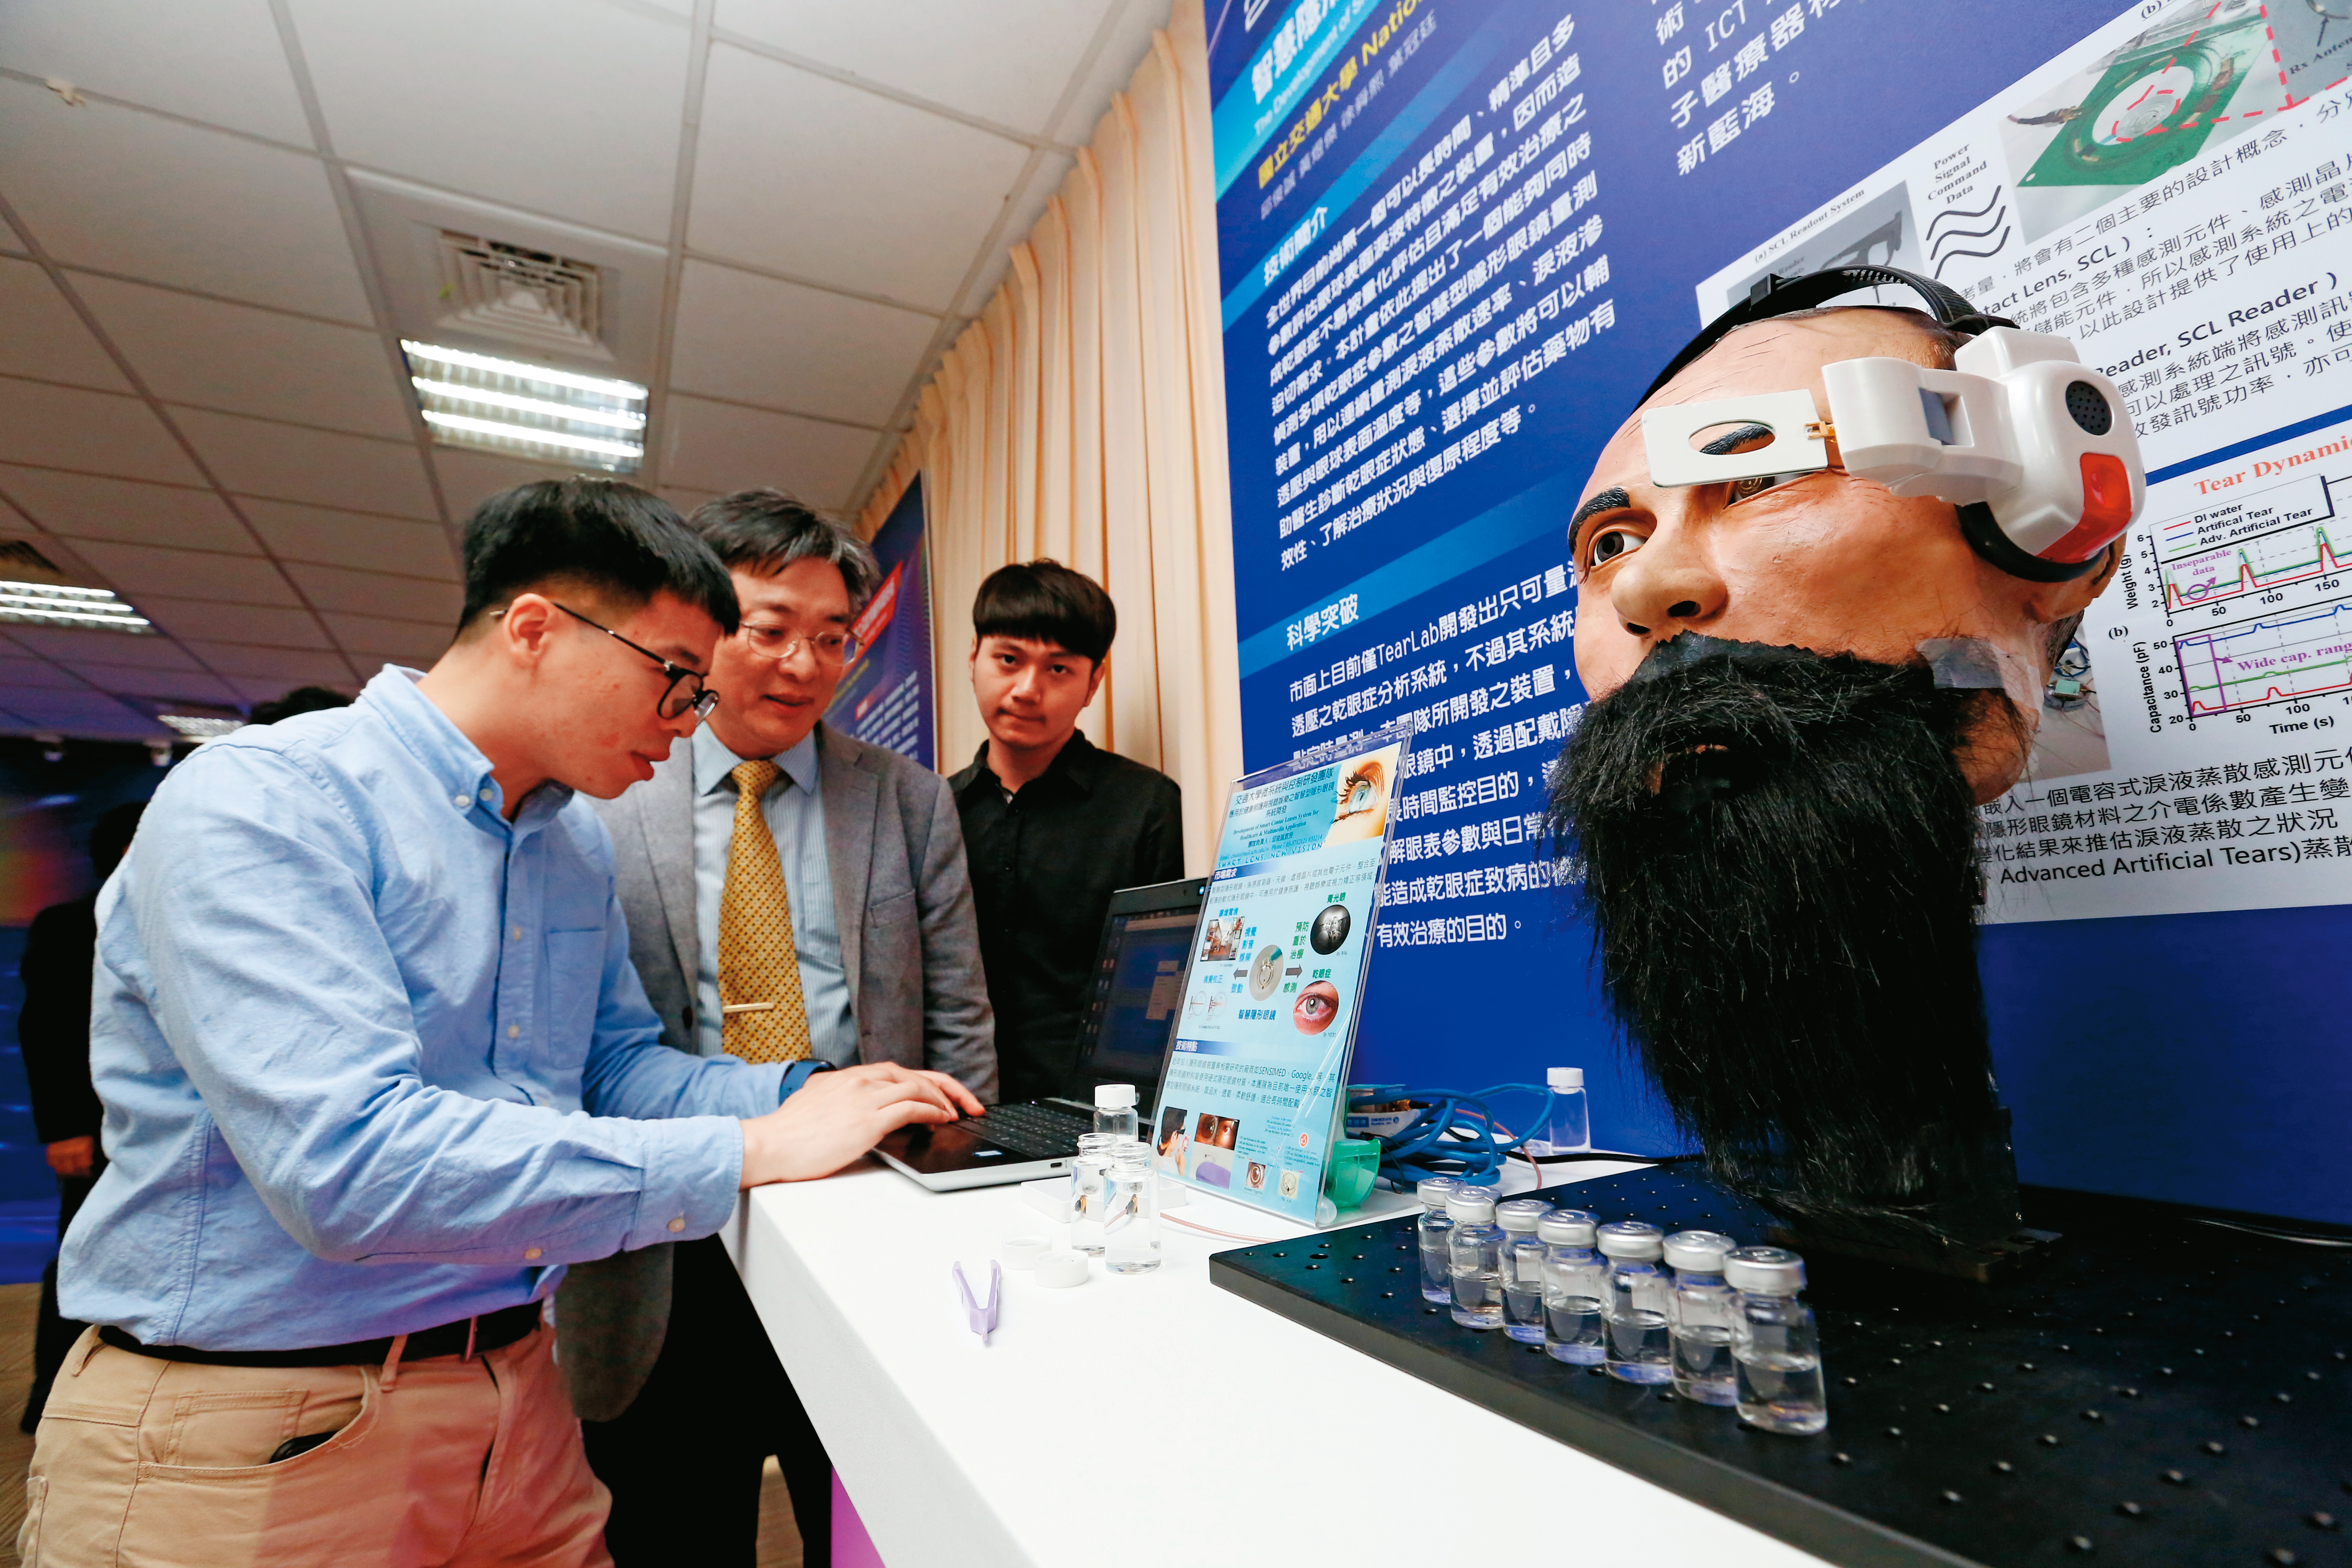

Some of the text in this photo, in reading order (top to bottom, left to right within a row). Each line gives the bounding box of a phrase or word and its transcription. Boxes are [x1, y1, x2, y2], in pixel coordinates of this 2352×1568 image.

[1361, 0, 1423, 67] Natio
[1662, 0, 1746, 89] 的 ICT
[1933, 143, 1970, 170] Power
[1935, 155, 1971, 183] Signal
[1927, 160, 1988, 200] Command
[1946, 185, 1974, 205] Data
[1790, 212, 1829, 240] Readout
[1830, 189, 1865, 214] System
[1263, 206, 1328, 287] 技術簡介
[1979, 291, 2019, 316] tact
[2022, 269, 2072, 298] Lens,
[2118, 290, 2352, 398] 感測系統端將感測訊
[2177, 321, 2223, 348] SCL
[2194, 470, 2246, 495] Tear
[2209, 504, 2243, 519] water
[2246, 507, 2274, 520] Tear
[2200, 508, 2313, 546] Adv. Artificial Tear
[2171, 550, 2232, 571] Inseparable
[2192, 565, 2215, 576] data
[2120, 570, 2138, 610] Weight
[2212, 606, 2226, 616] 50
[2260, 592, 2283, 605] 100
[2314, 579, 2340, 592] 150
[1286, 593, 1359, 651] 科學突破
[2108, 625, 2129, 640] (b)
[2153, 641, 2167, 650] 50
[2158, 665, 2173, 674] 40
[2237, 657, 2276, 671] Wide
[2281, 652, 2312, 663] cap.
[2133, 641, 2162, 733] Capacitance (pF)
[2164, 690, 2178, 699] 30
[2169, 715, 2184, 724] 20
[2189, 703, 2311, 731] 0 50 100
[2269, 716, 2334, 735] Time (s)
[1233, 826, 1255, 835] Development
[1259, 820, 1271, 829] Smart
[1240, 832, 1258, 841] Healthcare
[1263, 826, 1285, 835] Multimedia
[1285, 821, 1307, 831] Application
[1270, 850, 1288, 858] NEW
[1214, 868, 1238, 880] 市場需求
[2000, 858, 2105, 884] Advanced
[2113, 848, 2214, 875] Artificial
[1295, 921, 1310, 933] 預防
[1376, 911, 1522, 949] 有效治療的目的。
[1289, 949, 1305, 960] 治療
[1312, 968, 1332, 979] 乾眼症
[1283, 982, 1298, 993] 感測
[1175, 1040, 1198, 1052] 技術特點
